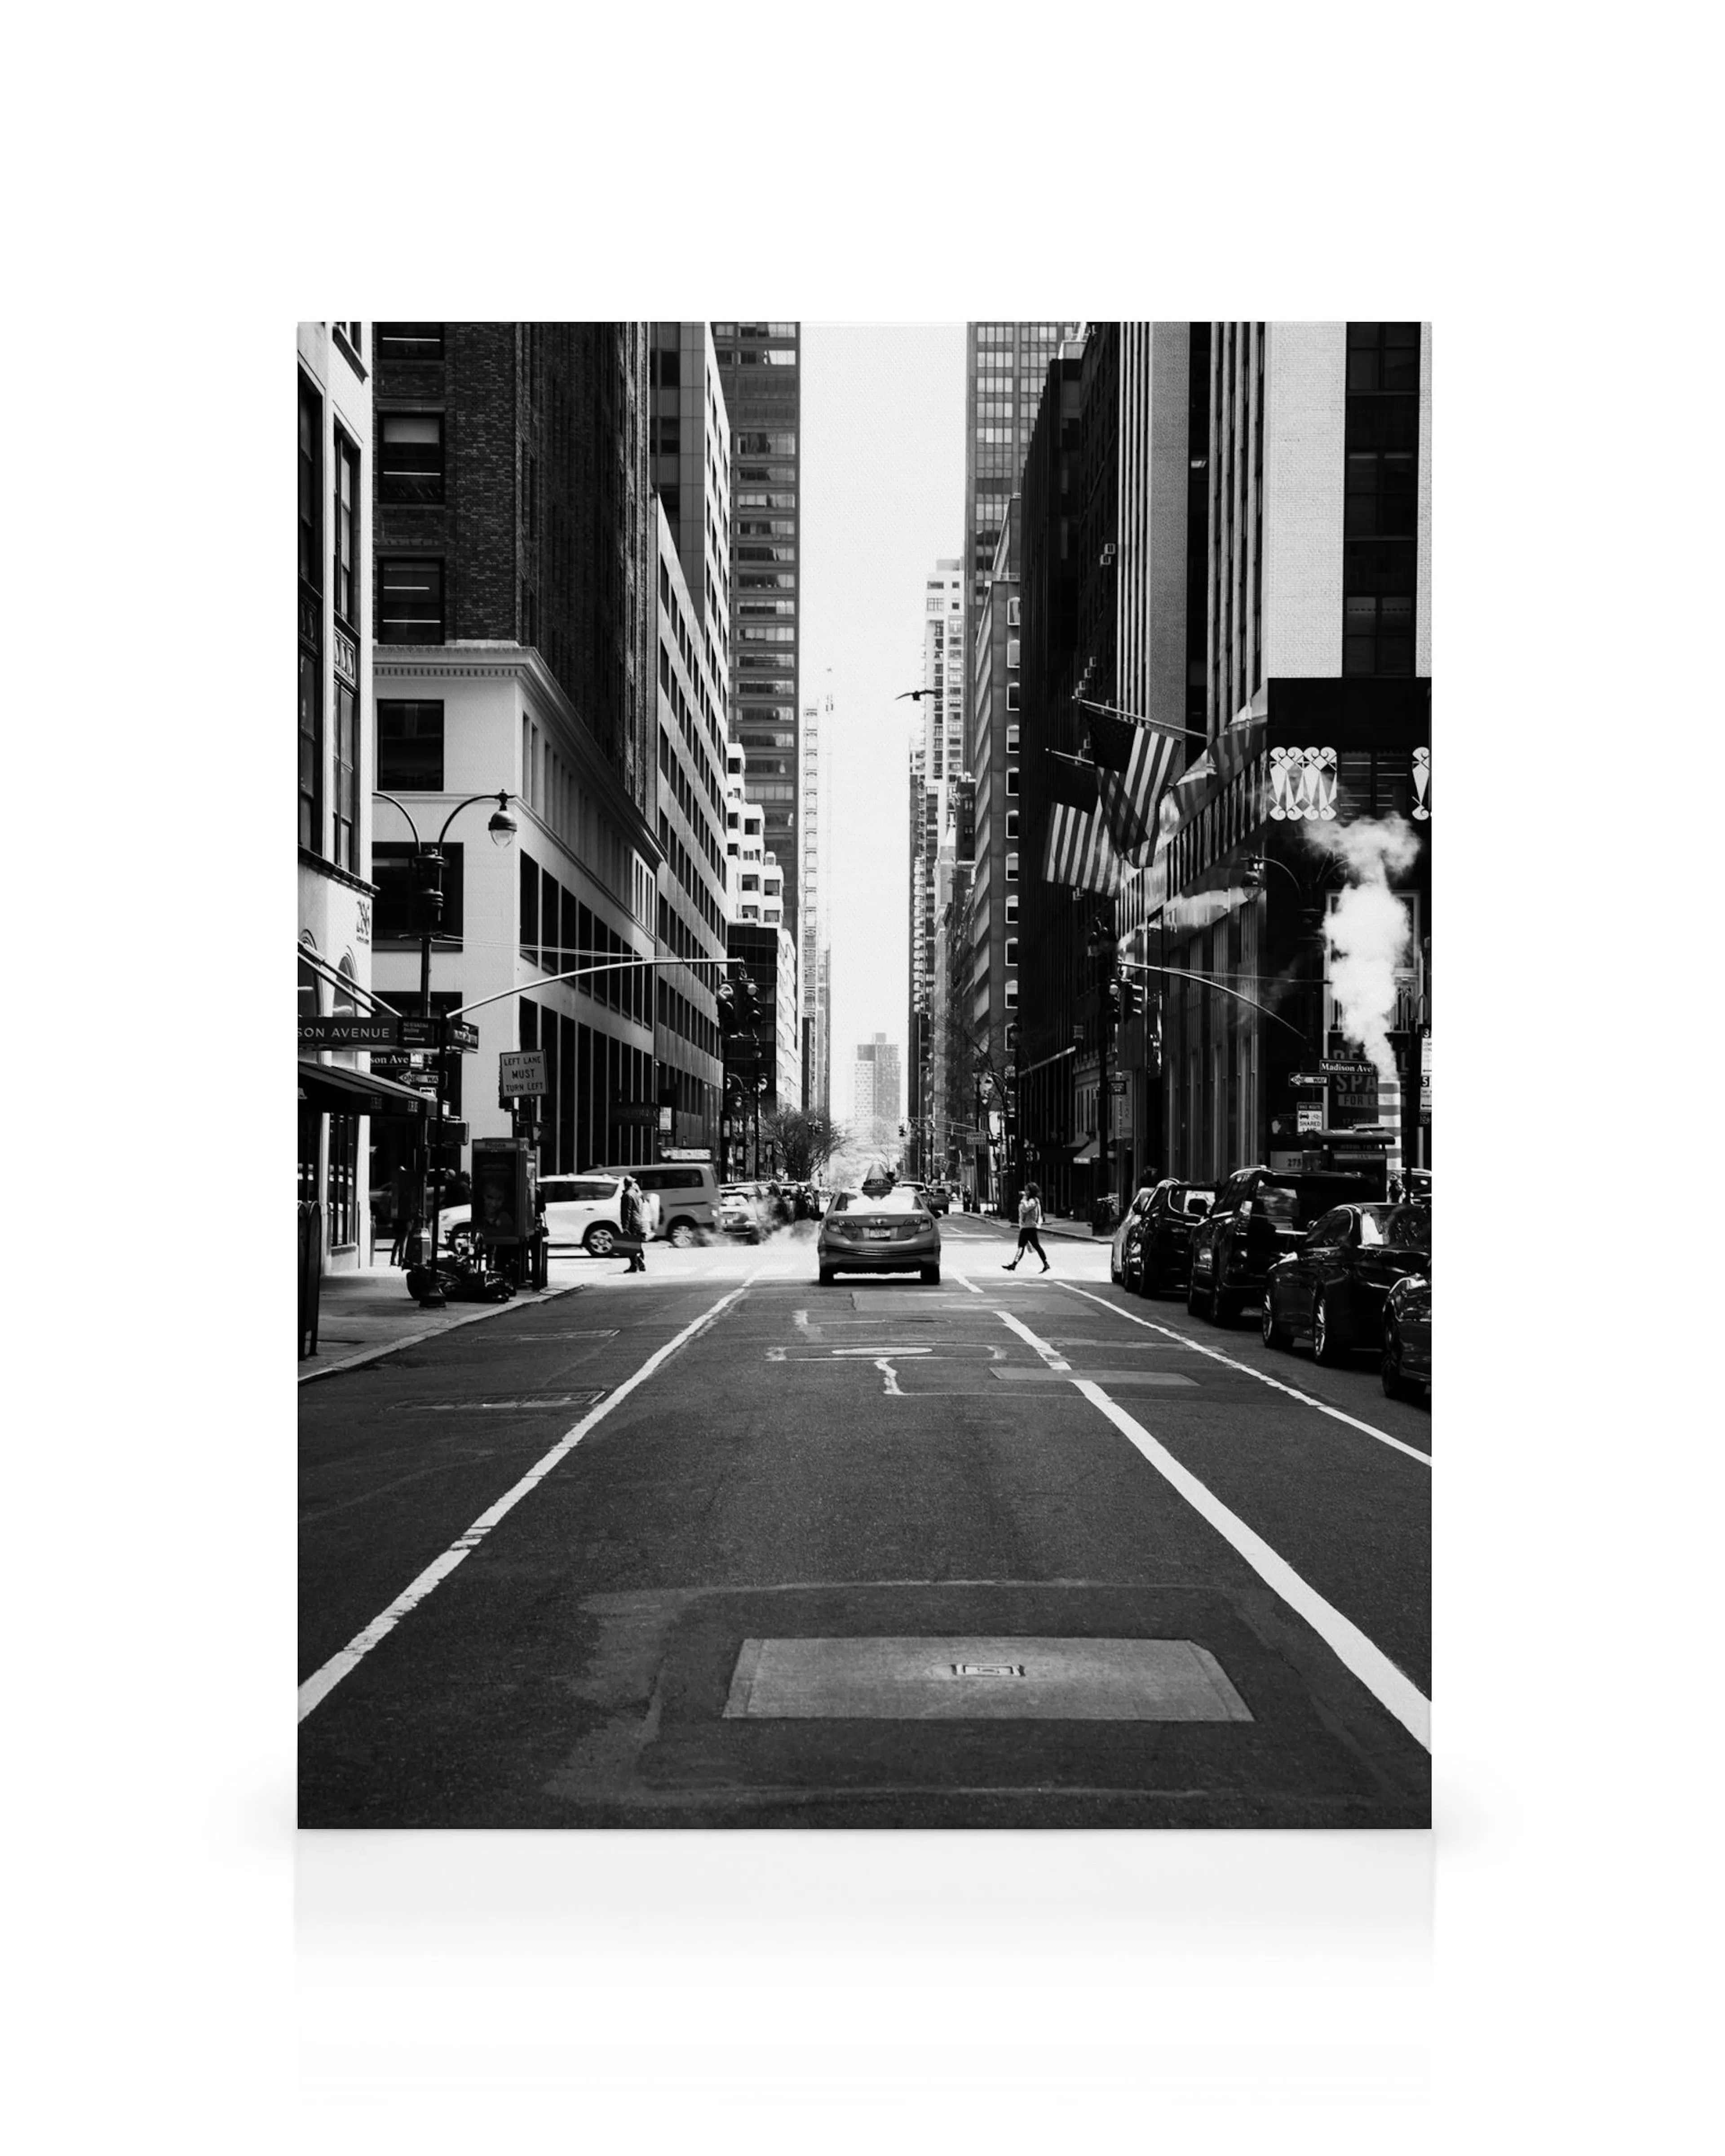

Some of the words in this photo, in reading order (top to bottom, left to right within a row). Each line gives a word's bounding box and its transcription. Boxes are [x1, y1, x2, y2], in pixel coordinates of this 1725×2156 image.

[331, 1027, 390, 1038] AVENUE
[389, 1055, 410, 1065] Ave
[504, 1057, 520, 1066] LEFT
[523, 1056, 542, 1065] LANE
[1321, 1062, 1355, 1073] Madison
[1356, 1064, 1372, 1073] Ave
[512, 1068, 535, 1079] MUST
[505, 1083, 524, 1092] TURN
[527, 1081, 543, 1091] LEFT
[1344, 1095, 1363, 1105] FOR
